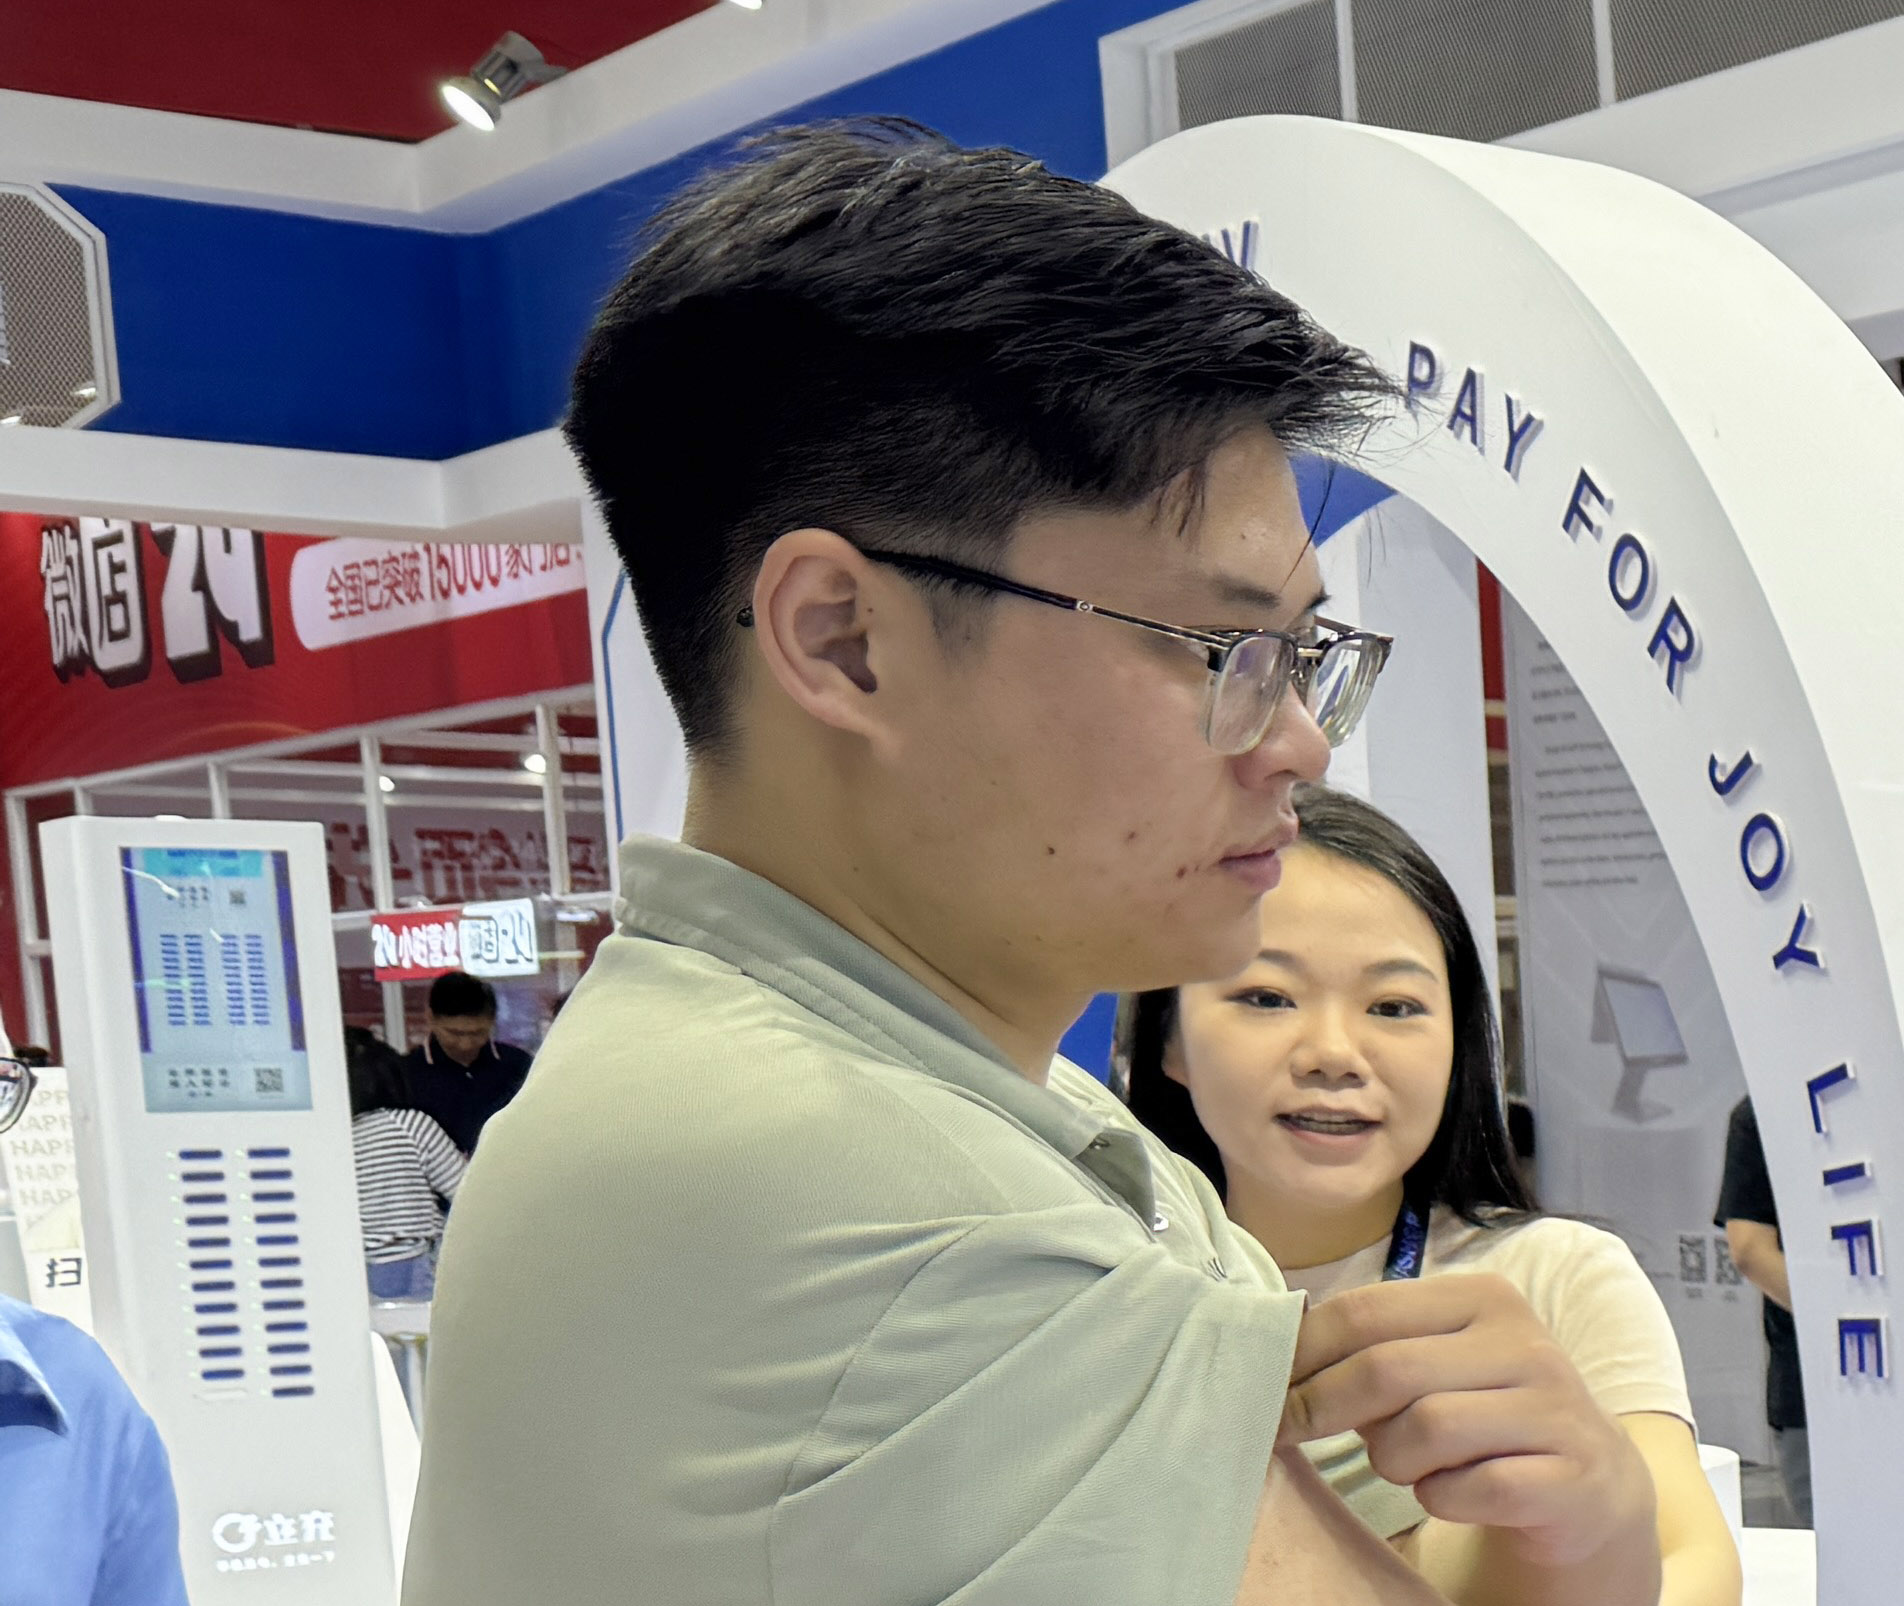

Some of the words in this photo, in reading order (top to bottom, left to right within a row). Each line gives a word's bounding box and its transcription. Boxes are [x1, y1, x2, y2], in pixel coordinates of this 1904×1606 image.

[1407, 340, 1536, 473] PAY
[1561, 467, 1695, 695] FOR
[1709, 750, 1822, 970] JOY
[1806, 1062, 1886, 1378] LIFE
